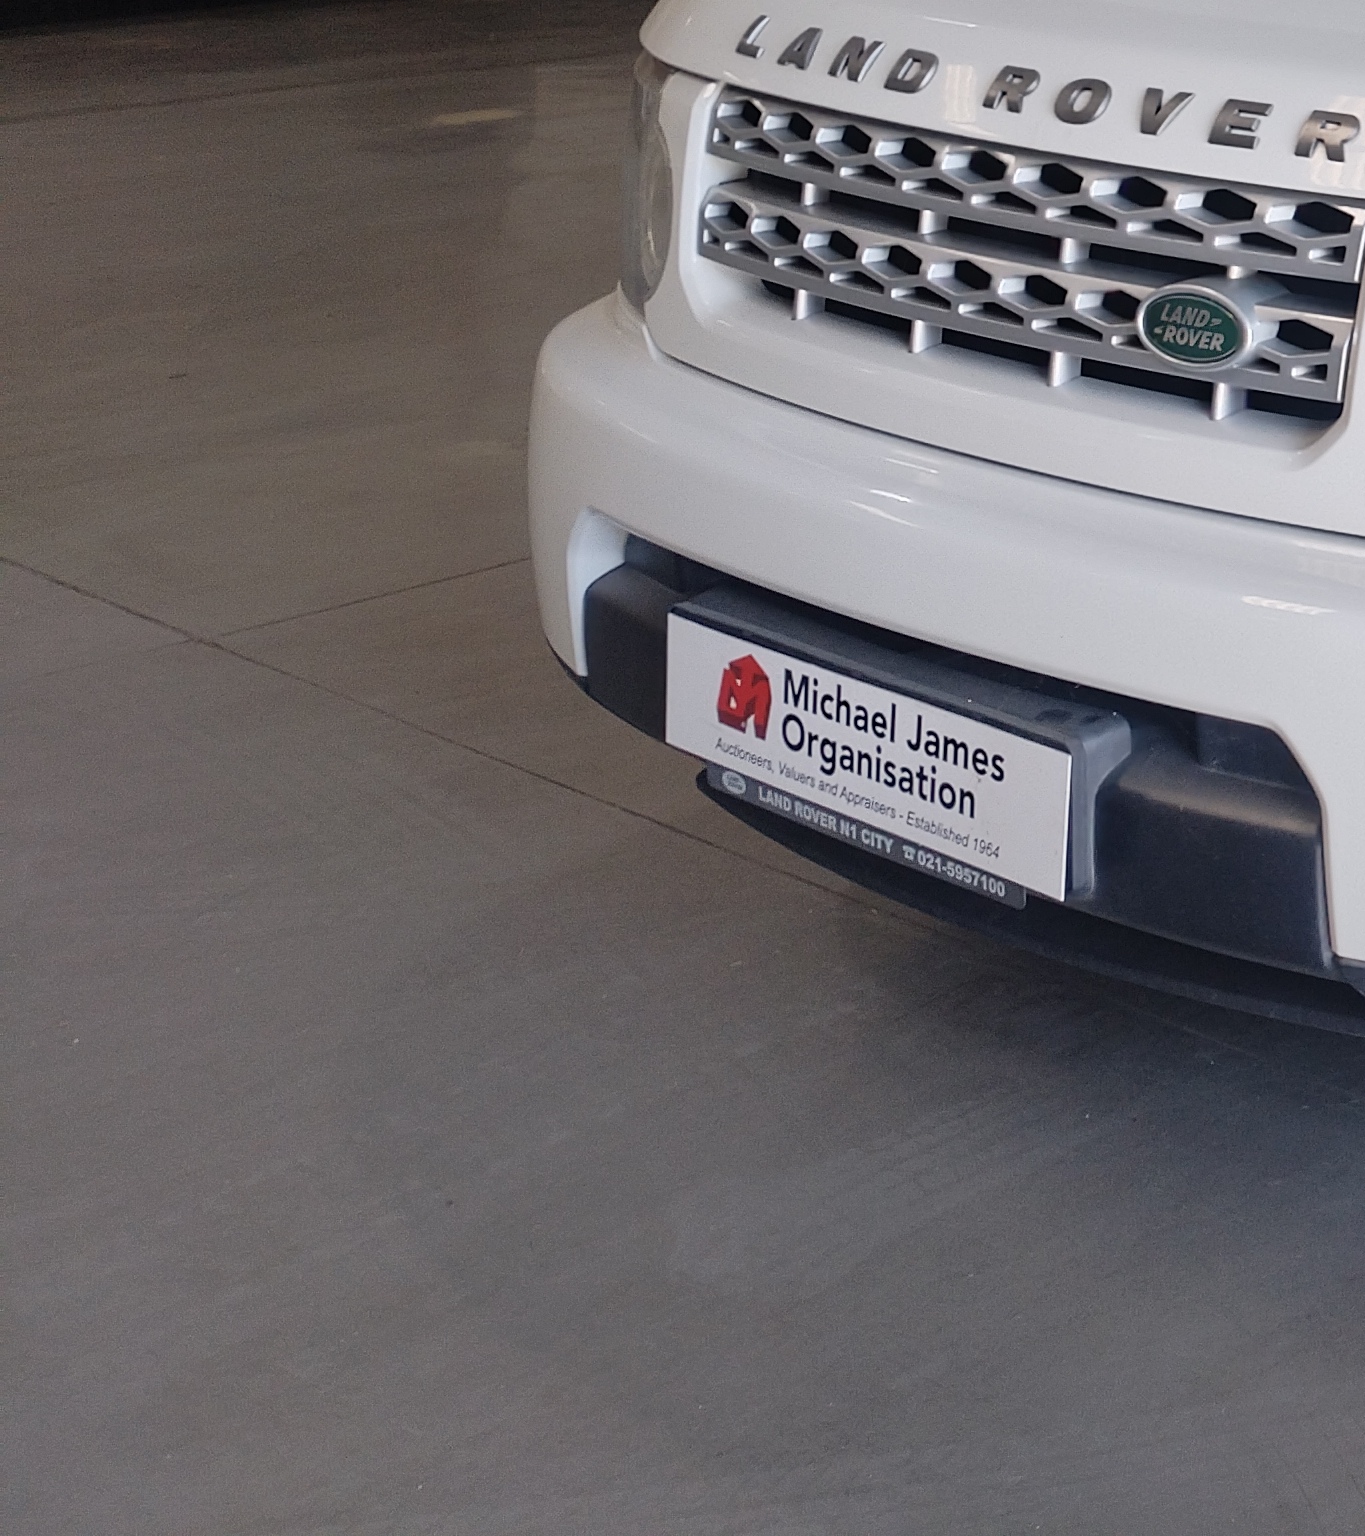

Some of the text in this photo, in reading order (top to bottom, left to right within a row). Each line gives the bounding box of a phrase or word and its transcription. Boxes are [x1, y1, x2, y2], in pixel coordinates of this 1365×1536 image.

[735, 15, 1365, 163] LAND ROVER
[782, 713, 976, 819] Organisation
[783, 668, 1006, 782] Michael James
[714, 737, 774, 774] Auctioneers,
[778, 761, 815, 790] Valuers
[818, 777, 839, 797] and
[839, 785, 897, 818] Appraisers
[906, 810, 970, 848] Established
[973, 837, 1001, 859] 1964
[758, 785, 792, 812] LAND
[794, 799, 838, 832] ROVER
[839, 817, 858, 841] N1
[860, 828, 895, 855] CITY
